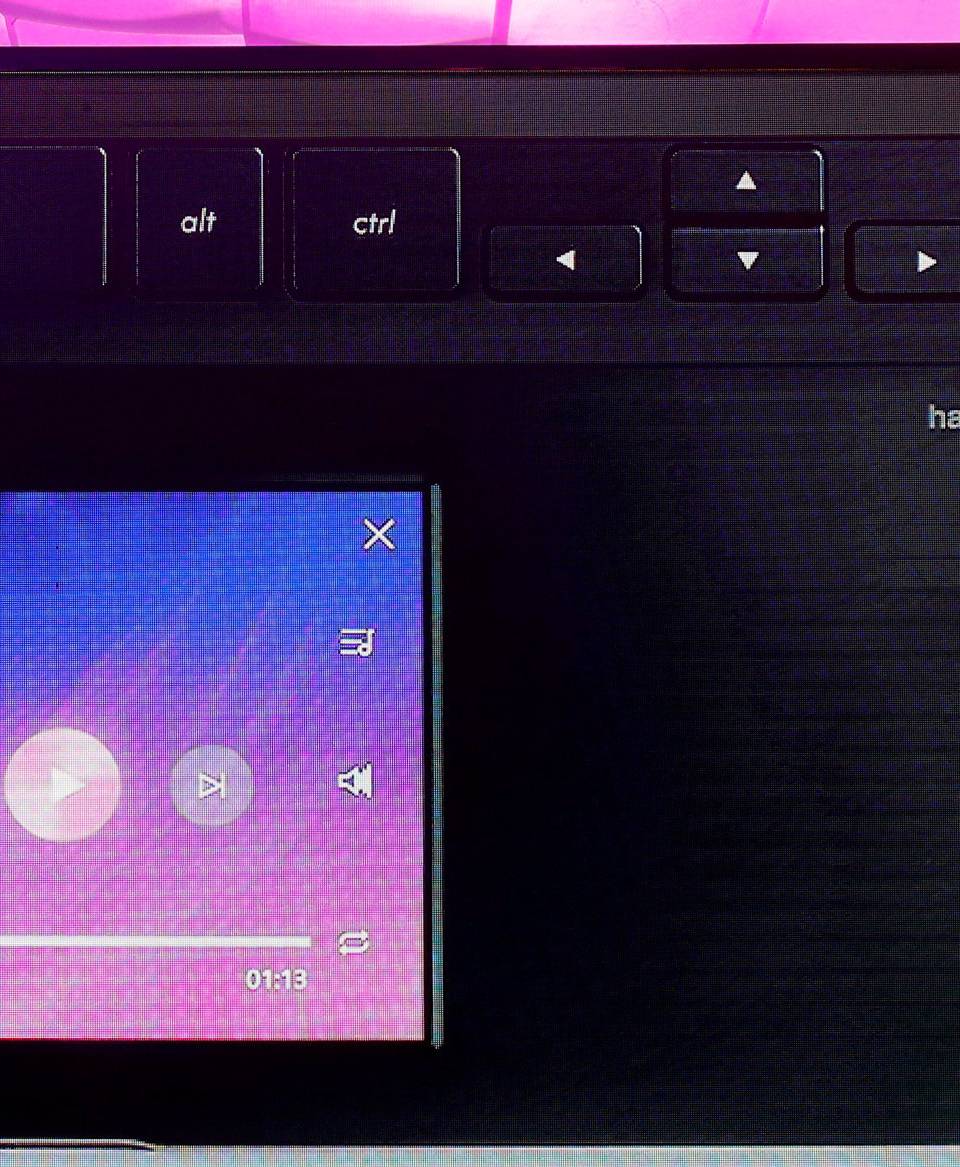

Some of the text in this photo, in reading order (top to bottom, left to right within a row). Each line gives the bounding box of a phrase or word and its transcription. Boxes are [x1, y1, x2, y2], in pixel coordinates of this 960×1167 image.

[181, 208, 216, 233] alt
[353, 209, 396, 234] ctrl
[246, 968, 308, 991] 01:13
